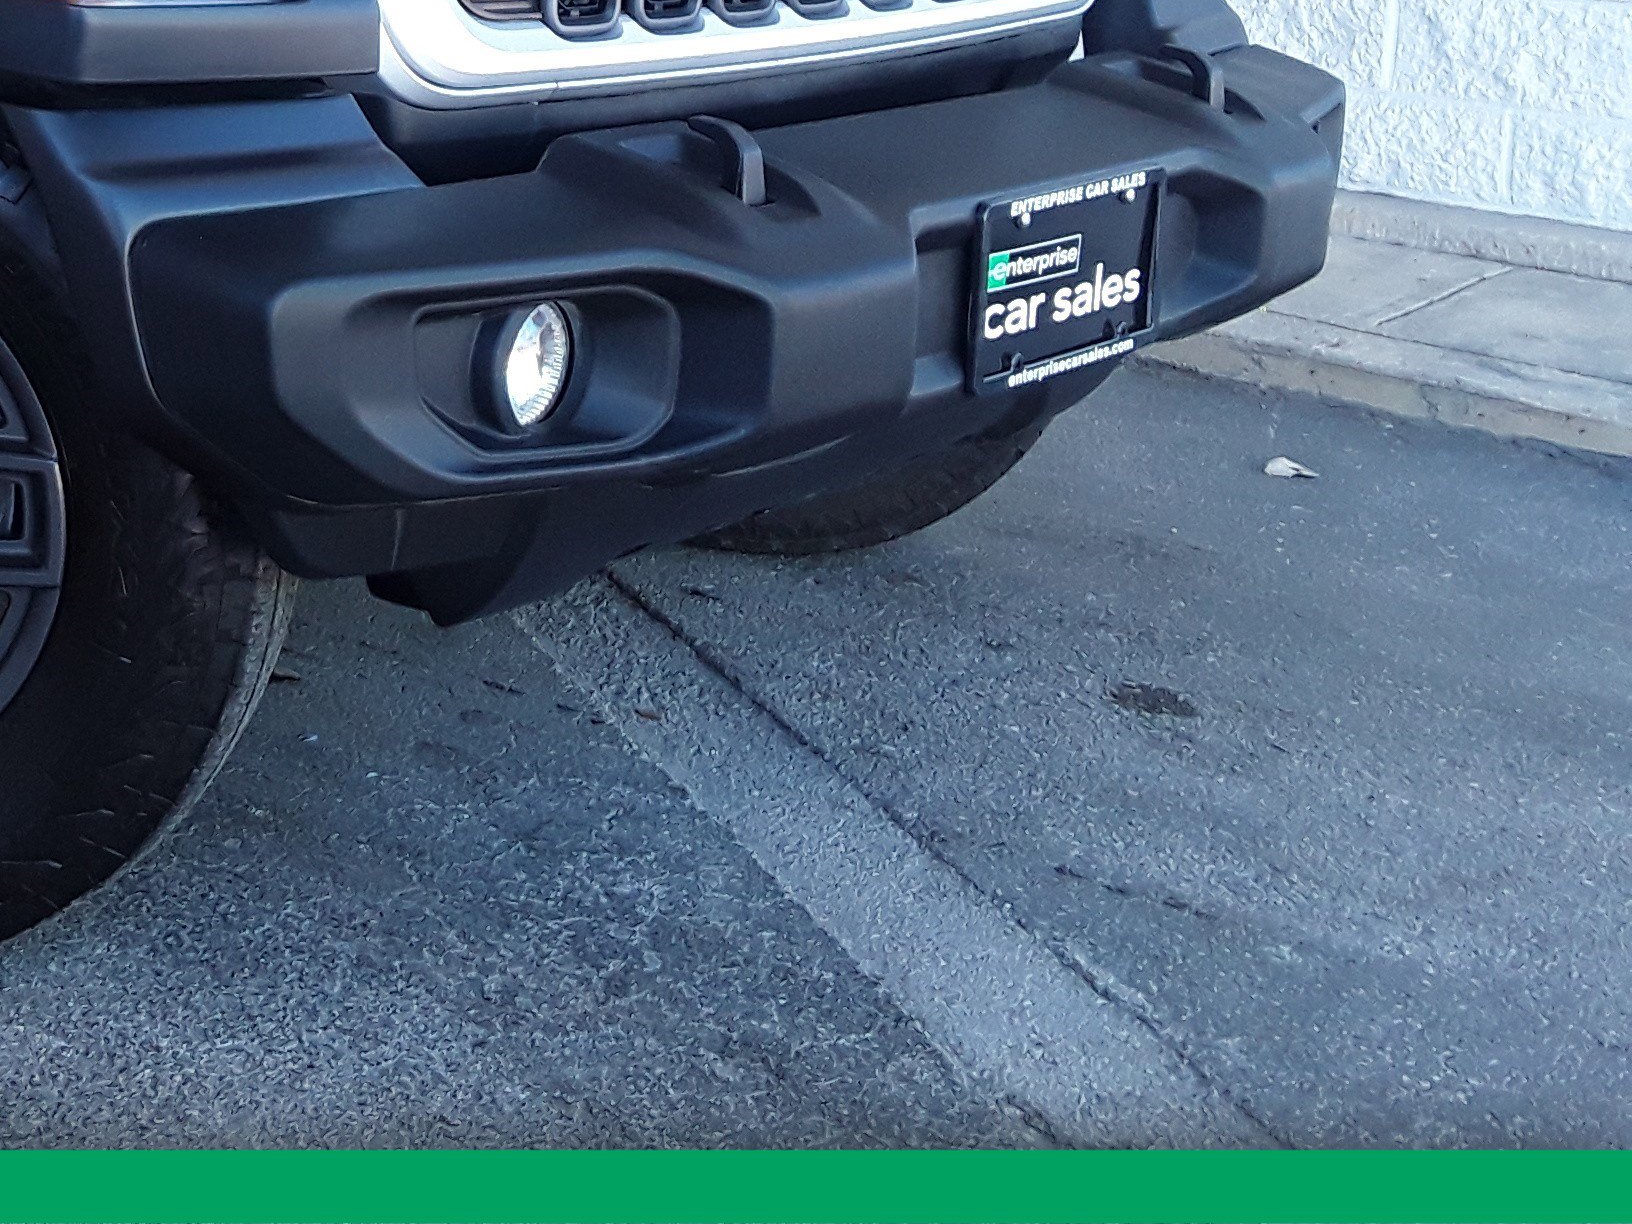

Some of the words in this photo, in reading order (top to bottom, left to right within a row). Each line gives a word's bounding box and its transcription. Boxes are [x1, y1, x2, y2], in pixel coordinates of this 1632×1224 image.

[1010, 186, 1084, 218] ENTERPRISE
[1085, 180, 1110, 200] CAR
[1111, 171, 1147, 193] SALES
[991, 244, 1079, 281] enterprise
[984, 291, 1046, 340] car
[1051, 262, 1142, 323] sales
[1008, 338, 1134, 388] enterprisecarsales.com
